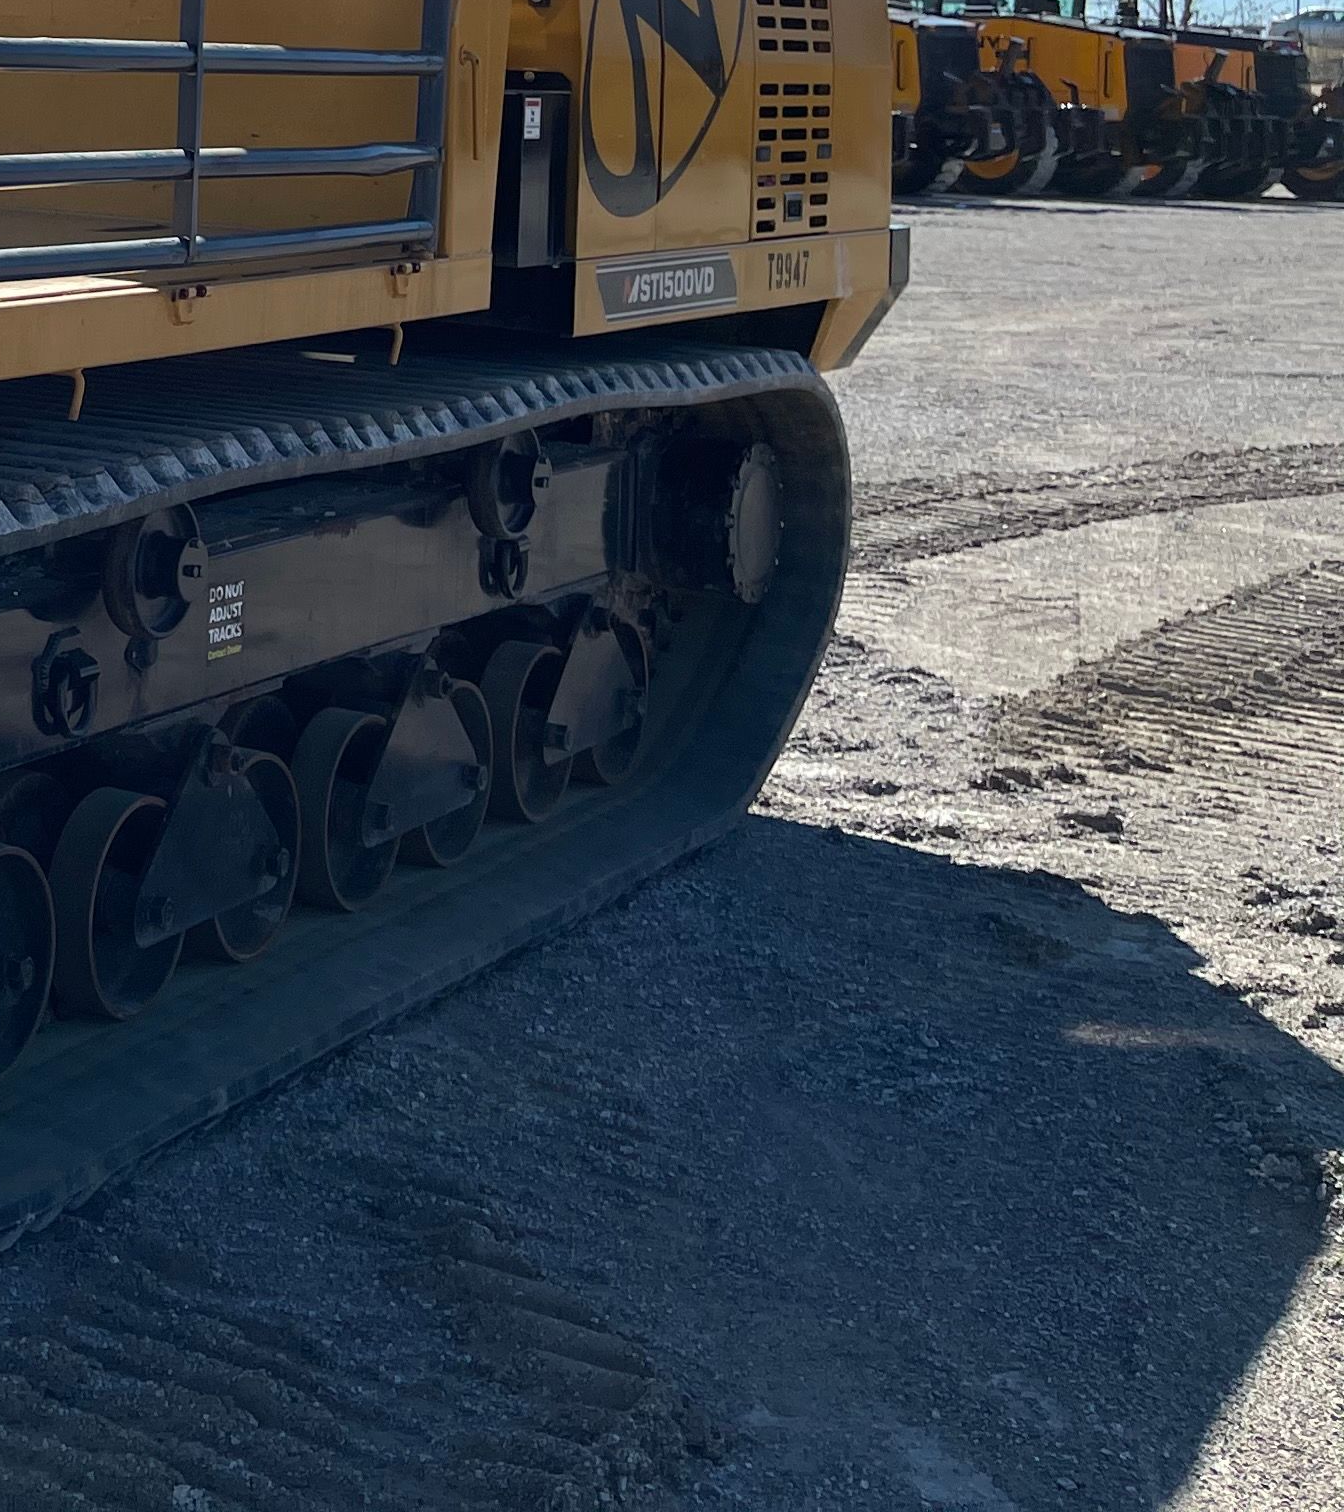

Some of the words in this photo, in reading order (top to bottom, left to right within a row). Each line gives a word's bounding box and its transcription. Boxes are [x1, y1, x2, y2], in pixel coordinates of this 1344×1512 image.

[767, 250, 810, 291] T9947
[209, 586, 224, 603] DO
[209, 601, 243, 623] ADJUST
[208, 622, 243, 644] TRACKS
